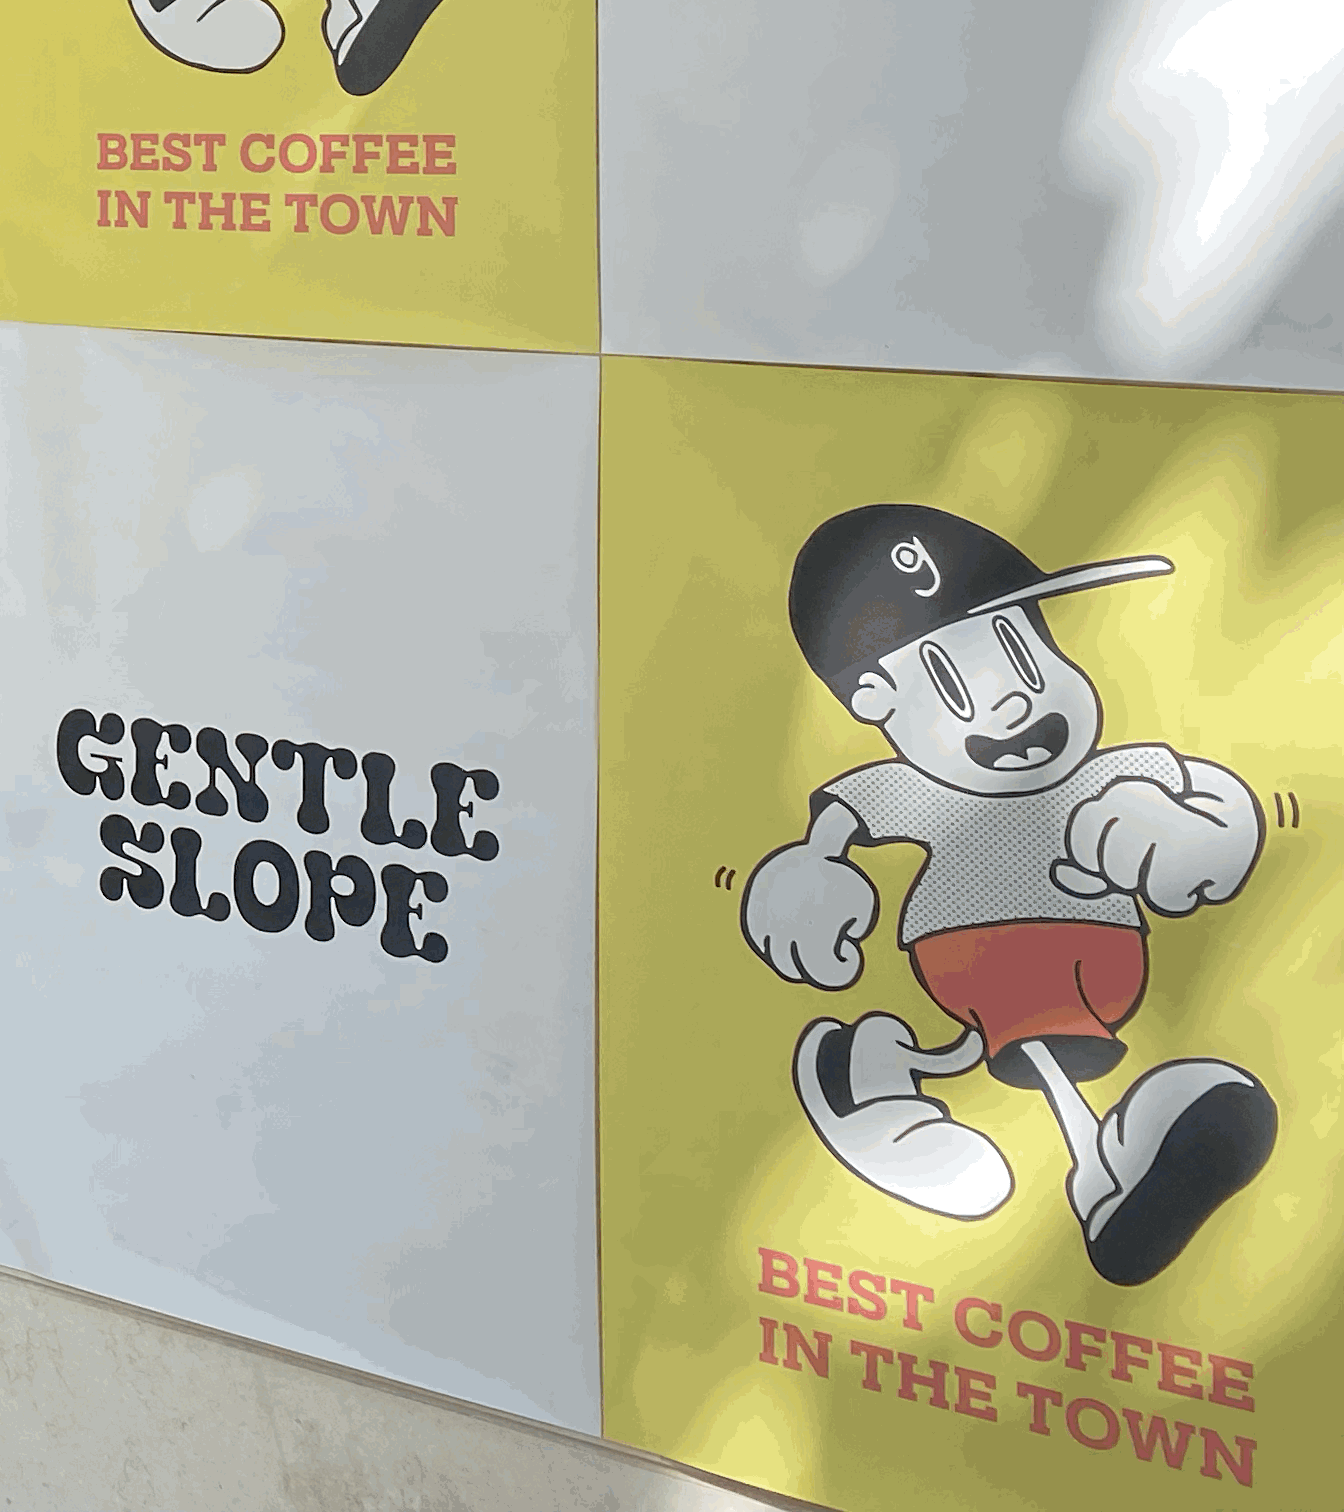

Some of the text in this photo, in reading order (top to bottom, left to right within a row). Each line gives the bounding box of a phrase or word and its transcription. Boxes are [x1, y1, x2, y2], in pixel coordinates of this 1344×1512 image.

[97, 133, 457, 175] BEST COFFEE
[97, 190, 459, 237] IN THE TOWN
[57, 709, 500, 861] GENTLE
[100, 814, 448, 963] SLOPE
[758, 1247, 1256, 1413] BEST COFFEE
[759, 1317, 1258, 1488] IN THE TOWN
